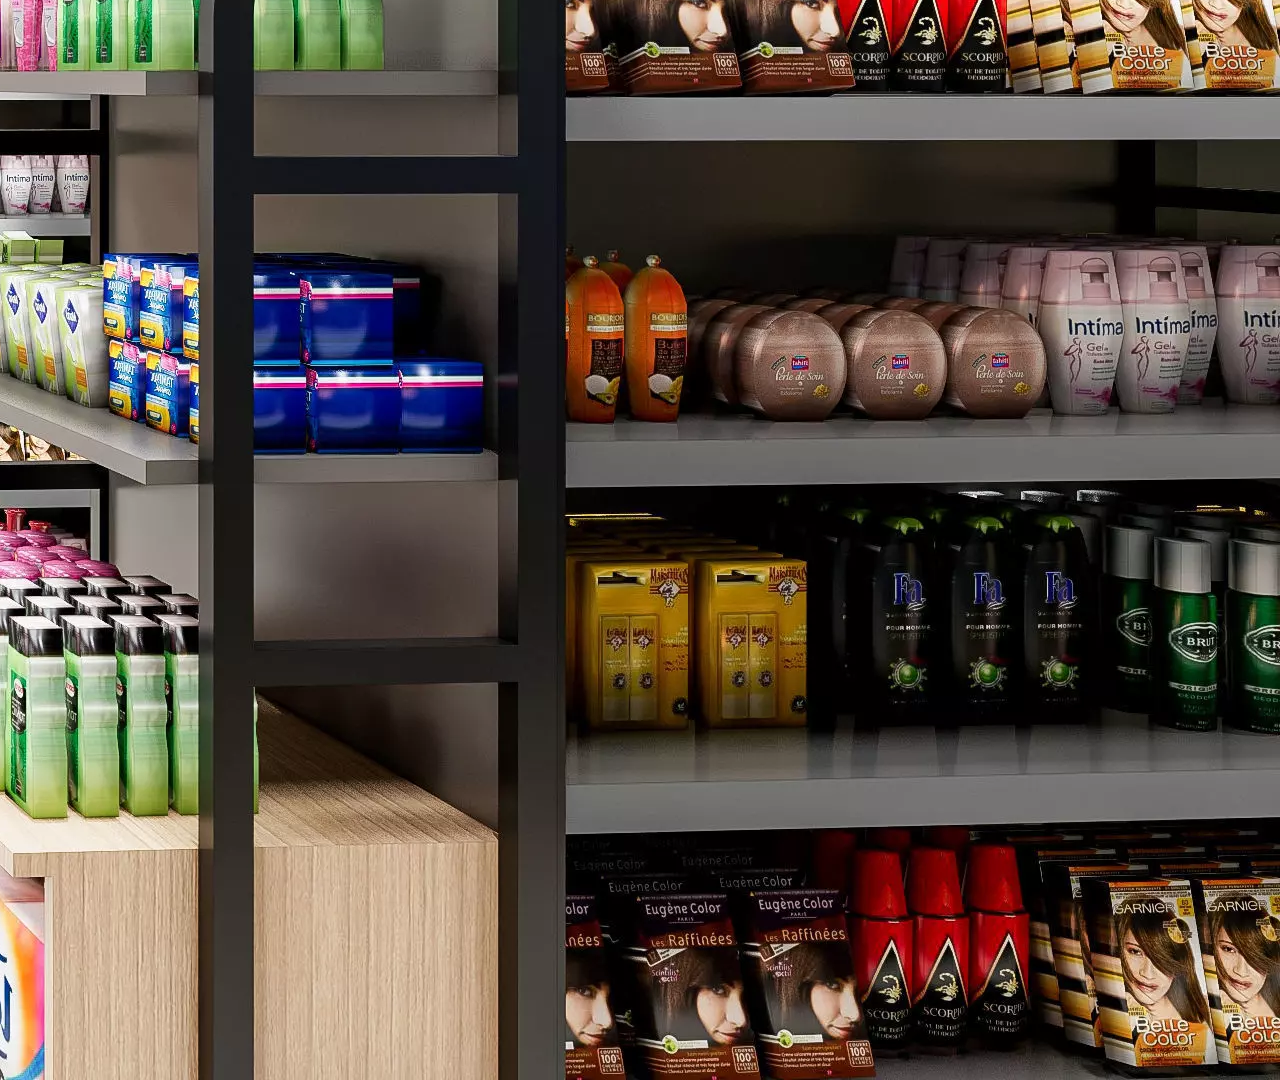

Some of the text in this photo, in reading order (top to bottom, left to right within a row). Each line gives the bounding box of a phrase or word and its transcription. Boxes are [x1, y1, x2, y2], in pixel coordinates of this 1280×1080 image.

[902, 52, 944, 64] SCORPIO
[962, 52, 1003, 64] SCORPIO
[1086, 342, 1105, 352] Gel
[1154, 341, 1172, 350] Gel
[795, 371, 805, 381] de
[807, 371, 824, 381] Soin
[896, 371, 906, 380] de
[907, 371, 924, 380] Soin
[1007, 369, 1024, 379] Soin
[893, 572, 927, 606] Fa
[973, 572, 1006, 606] Fa
[1045, 571, 1077, 605] Fa
[1186, 636, 1215, 647] BRUT
[645, 903, 721, 918] Eugène Color
[759, 897, 834, 912] Eugène Color
[1113, 900, 1176, 915] GARNIER
[1207, 900, 1269, 913] GARNIER
[651, 933, 733, 947] Les Raffinées
[764, 928, 846, 943] Les Raffinées
[735, 1052, 755, 1063] 100%
[849, 1047, 870, 1057] 100%
